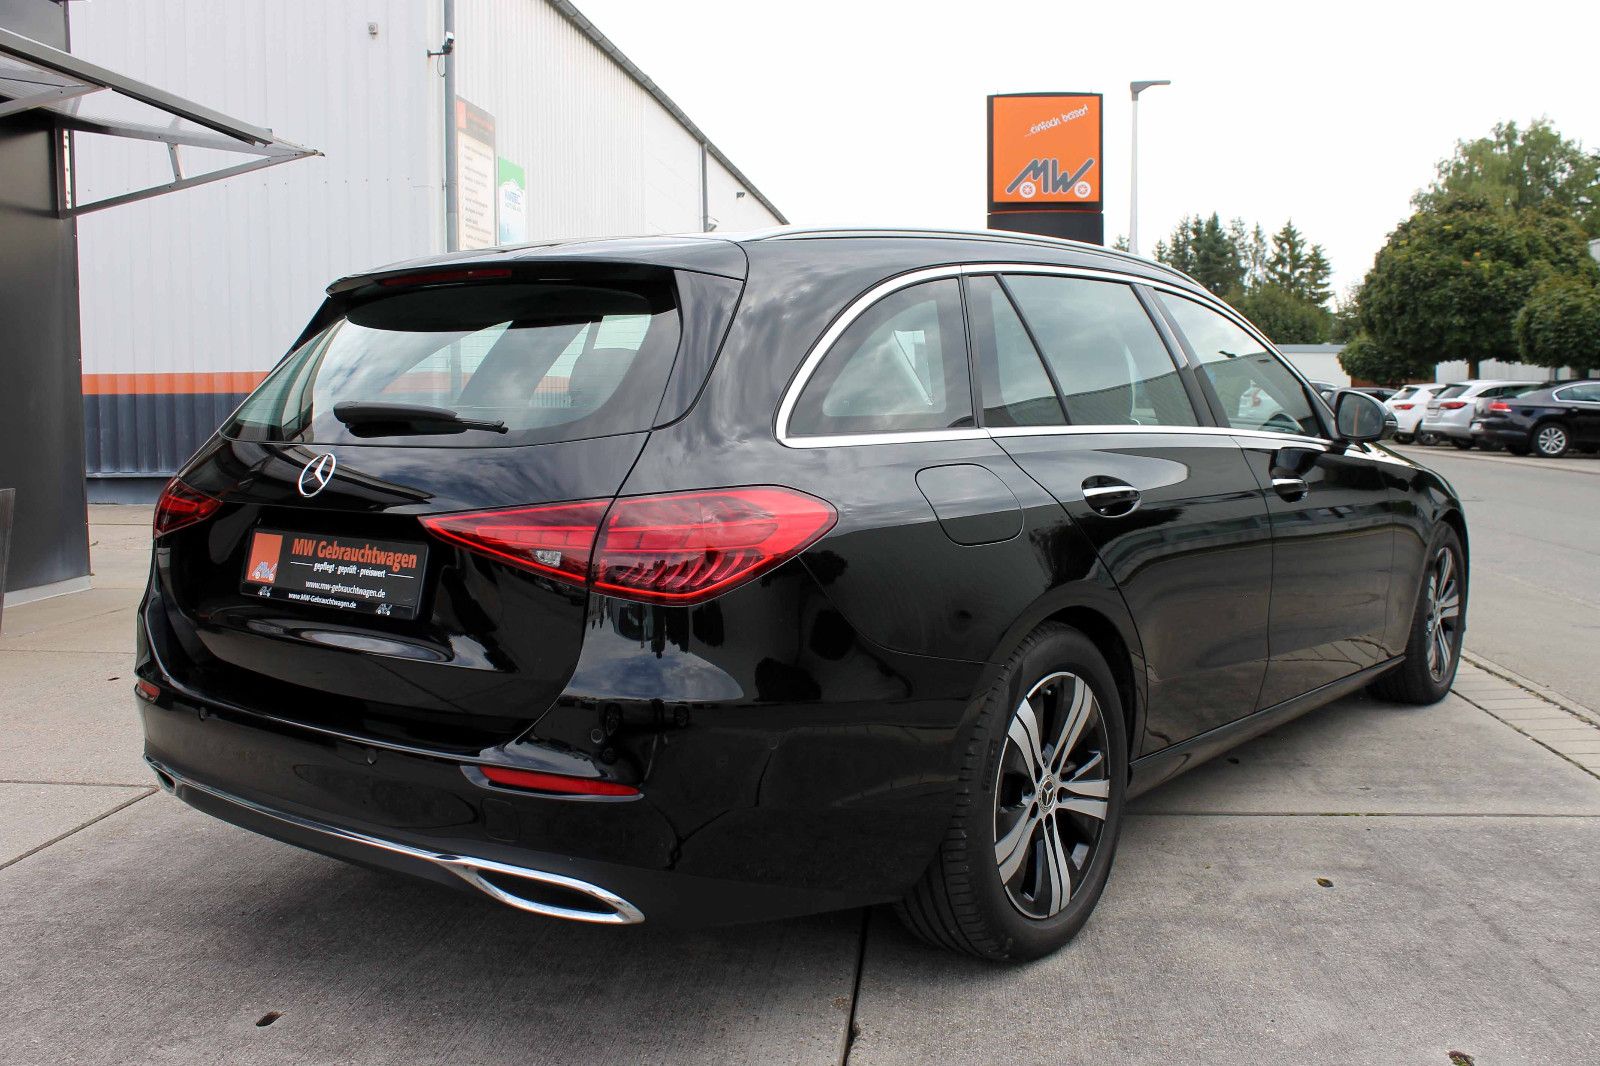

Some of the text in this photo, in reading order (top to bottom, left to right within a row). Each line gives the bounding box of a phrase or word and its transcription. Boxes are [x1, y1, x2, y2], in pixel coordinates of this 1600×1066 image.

[1006, 157, 1095, 195] MW
[292, 538, 417, 573] MW Gebrauchtwagen
[313, 562, 386, 578] gepflegt geprüft preiswert
[305, 581, 386, 599] www.mw-gebrauchtwagen.de
